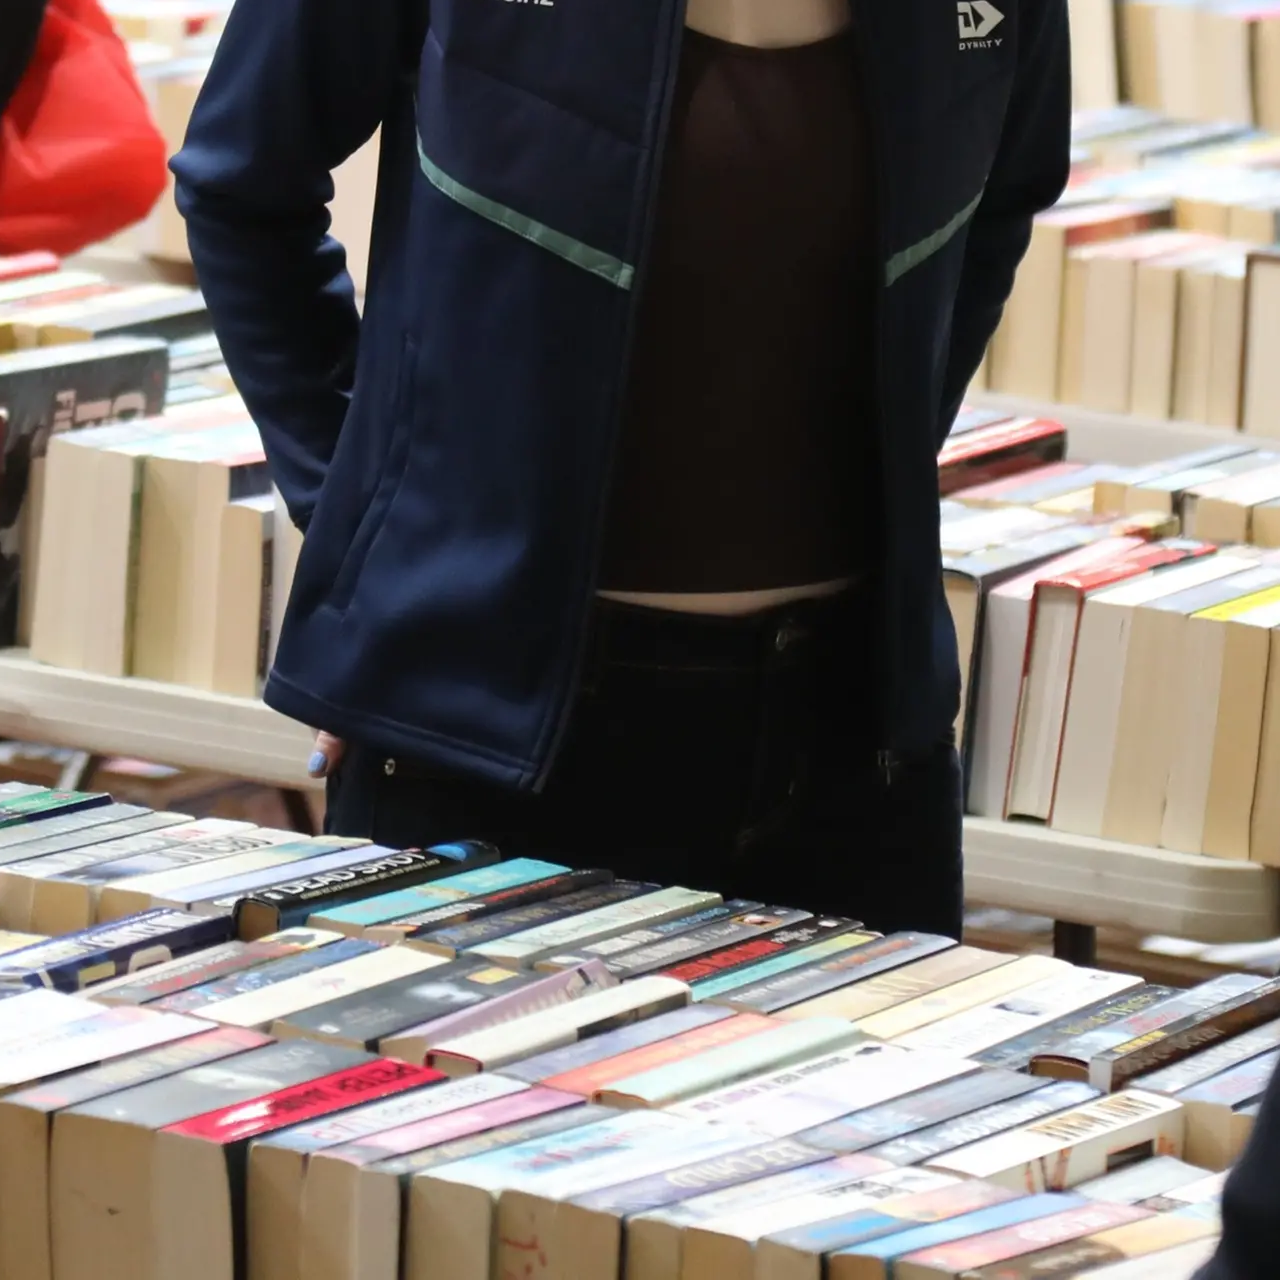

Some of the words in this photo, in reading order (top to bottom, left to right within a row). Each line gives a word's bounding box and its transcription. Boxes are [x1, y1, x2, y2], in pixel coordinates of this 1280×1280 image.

[277, 869, 355, 895] DEAD
[355, 850, 426, 874] SHOT
[666, 1157, 769, 1188] CHILD
